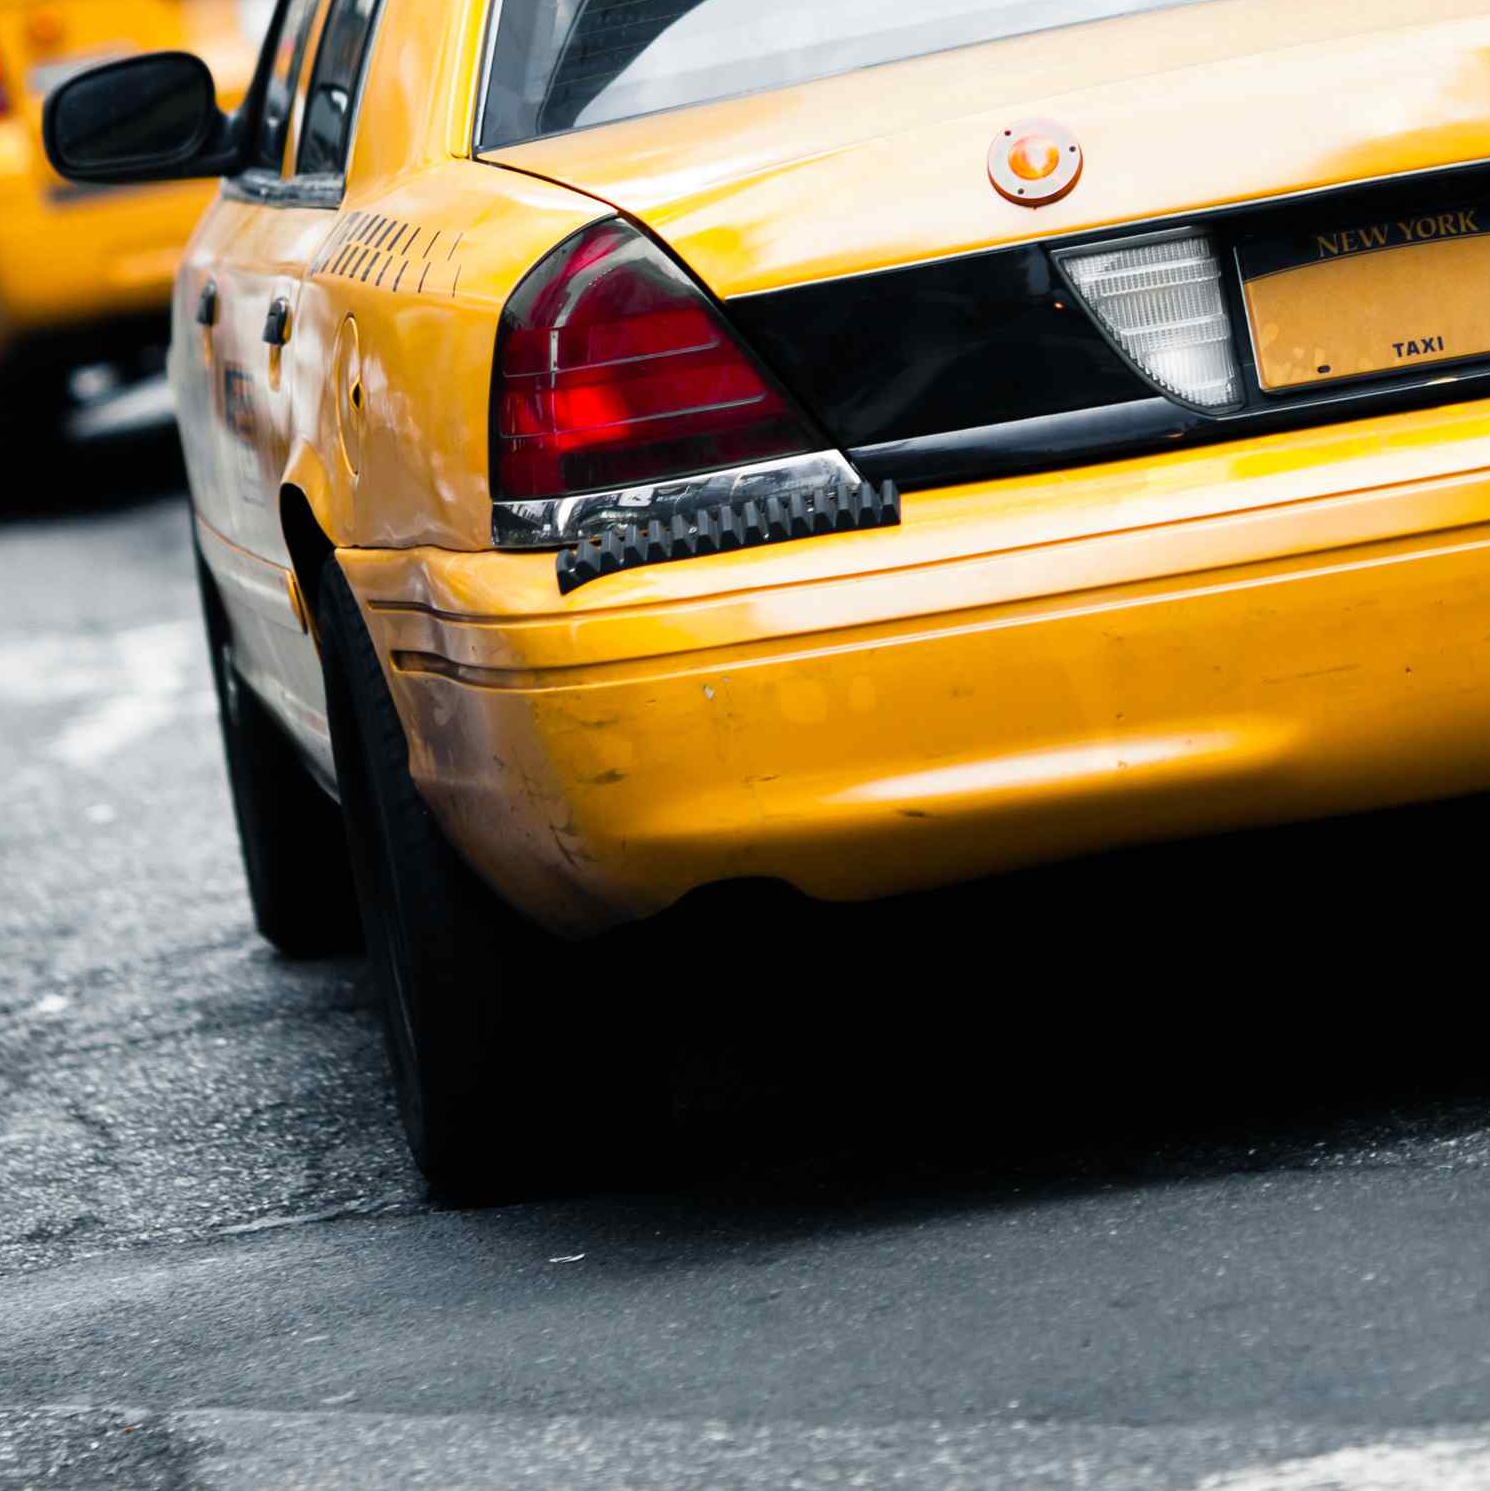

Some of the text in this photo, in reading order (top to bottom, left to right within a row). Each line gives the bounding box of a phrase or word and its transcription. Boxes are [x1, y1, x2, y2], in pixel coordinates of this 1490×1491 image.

[1316, 210, 1479, 257] NEW YORK
[1393, 336, 1444, 358] TAXI
